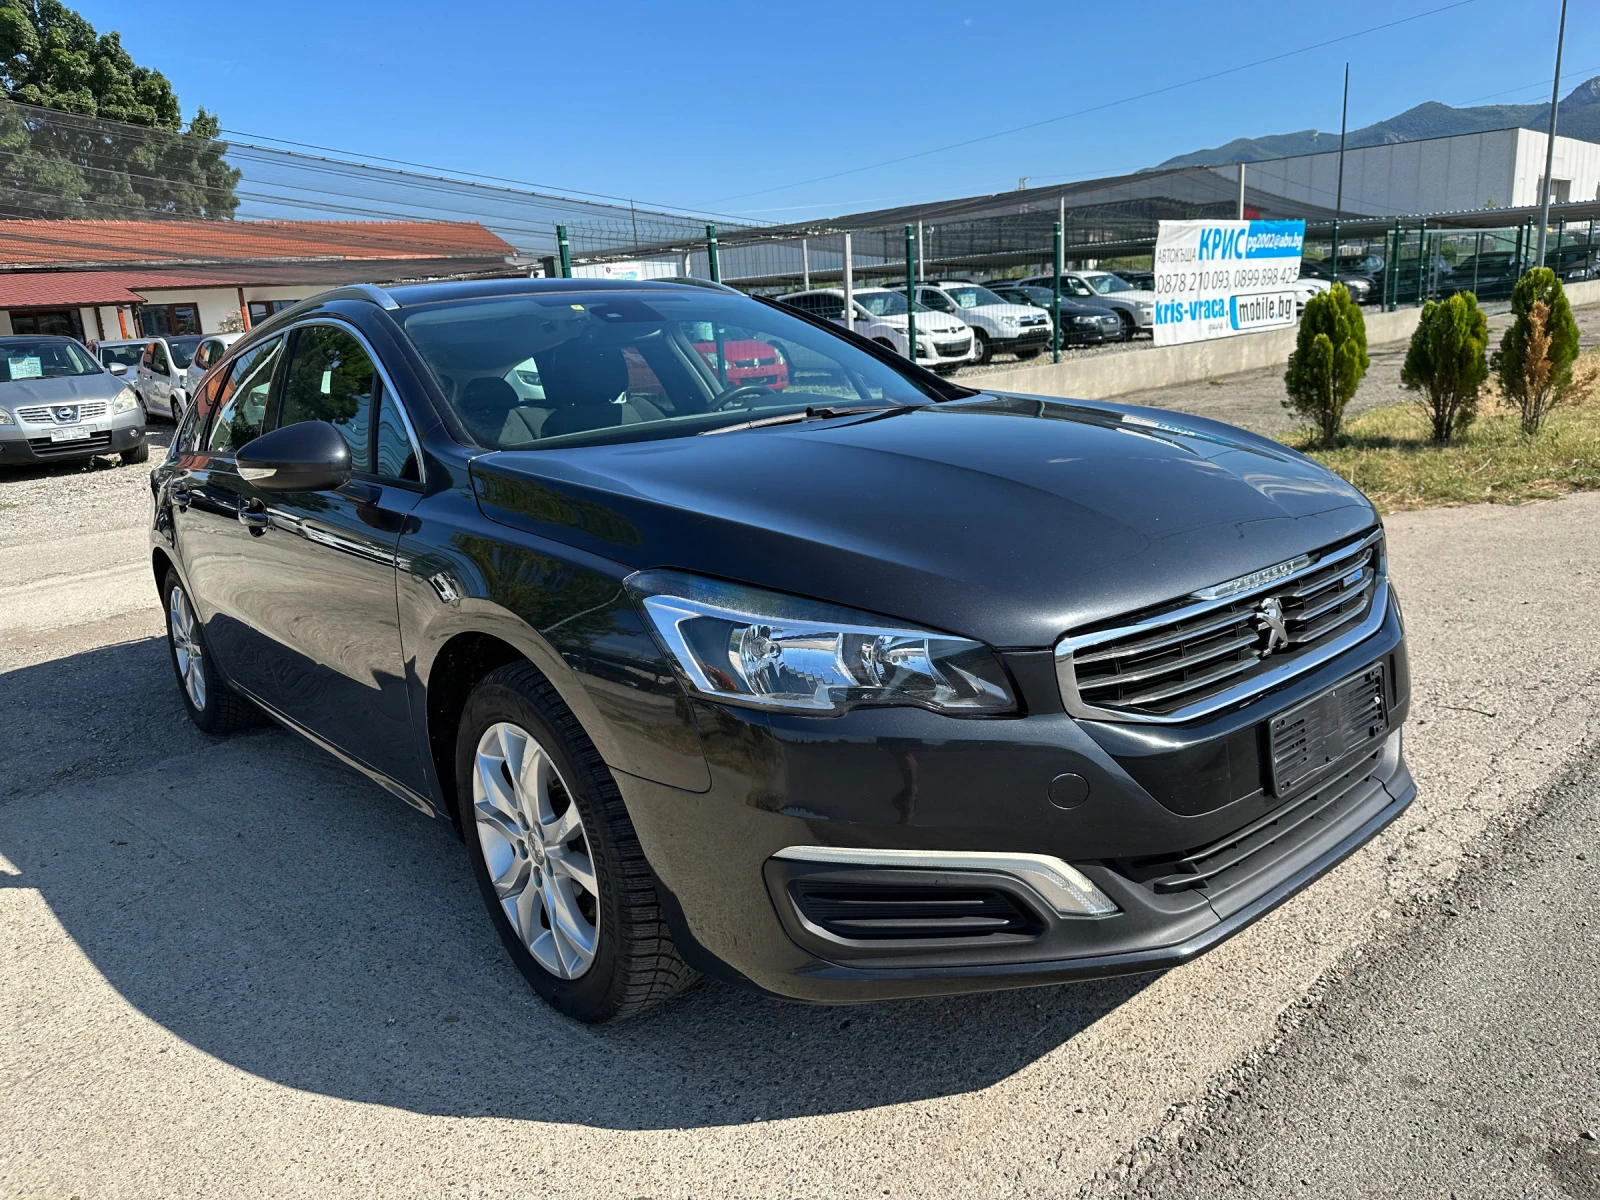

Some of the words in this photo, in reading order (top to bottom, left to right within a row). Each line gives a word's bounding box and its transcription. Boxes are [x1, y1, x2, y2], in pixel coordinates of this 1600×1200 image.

[1157, 247, 1196, 263] АВТОКЪЩА
[1198, 228, 1247, 260] КРИС
[1157, 272, 1187, 294] 0878
[1189, 271, 1210, 292] 210
[1234, 268, 1260, 289] 0899
[1260, 268, 1279, 287] 898
[1280, 266, 1299, 284] 425
[1239, 295, 1292, 322] mobile.bg
[1233, 560, 1295, 588] PEUGEOT
[576, 794, 615, 942] BRIDGESTONE
